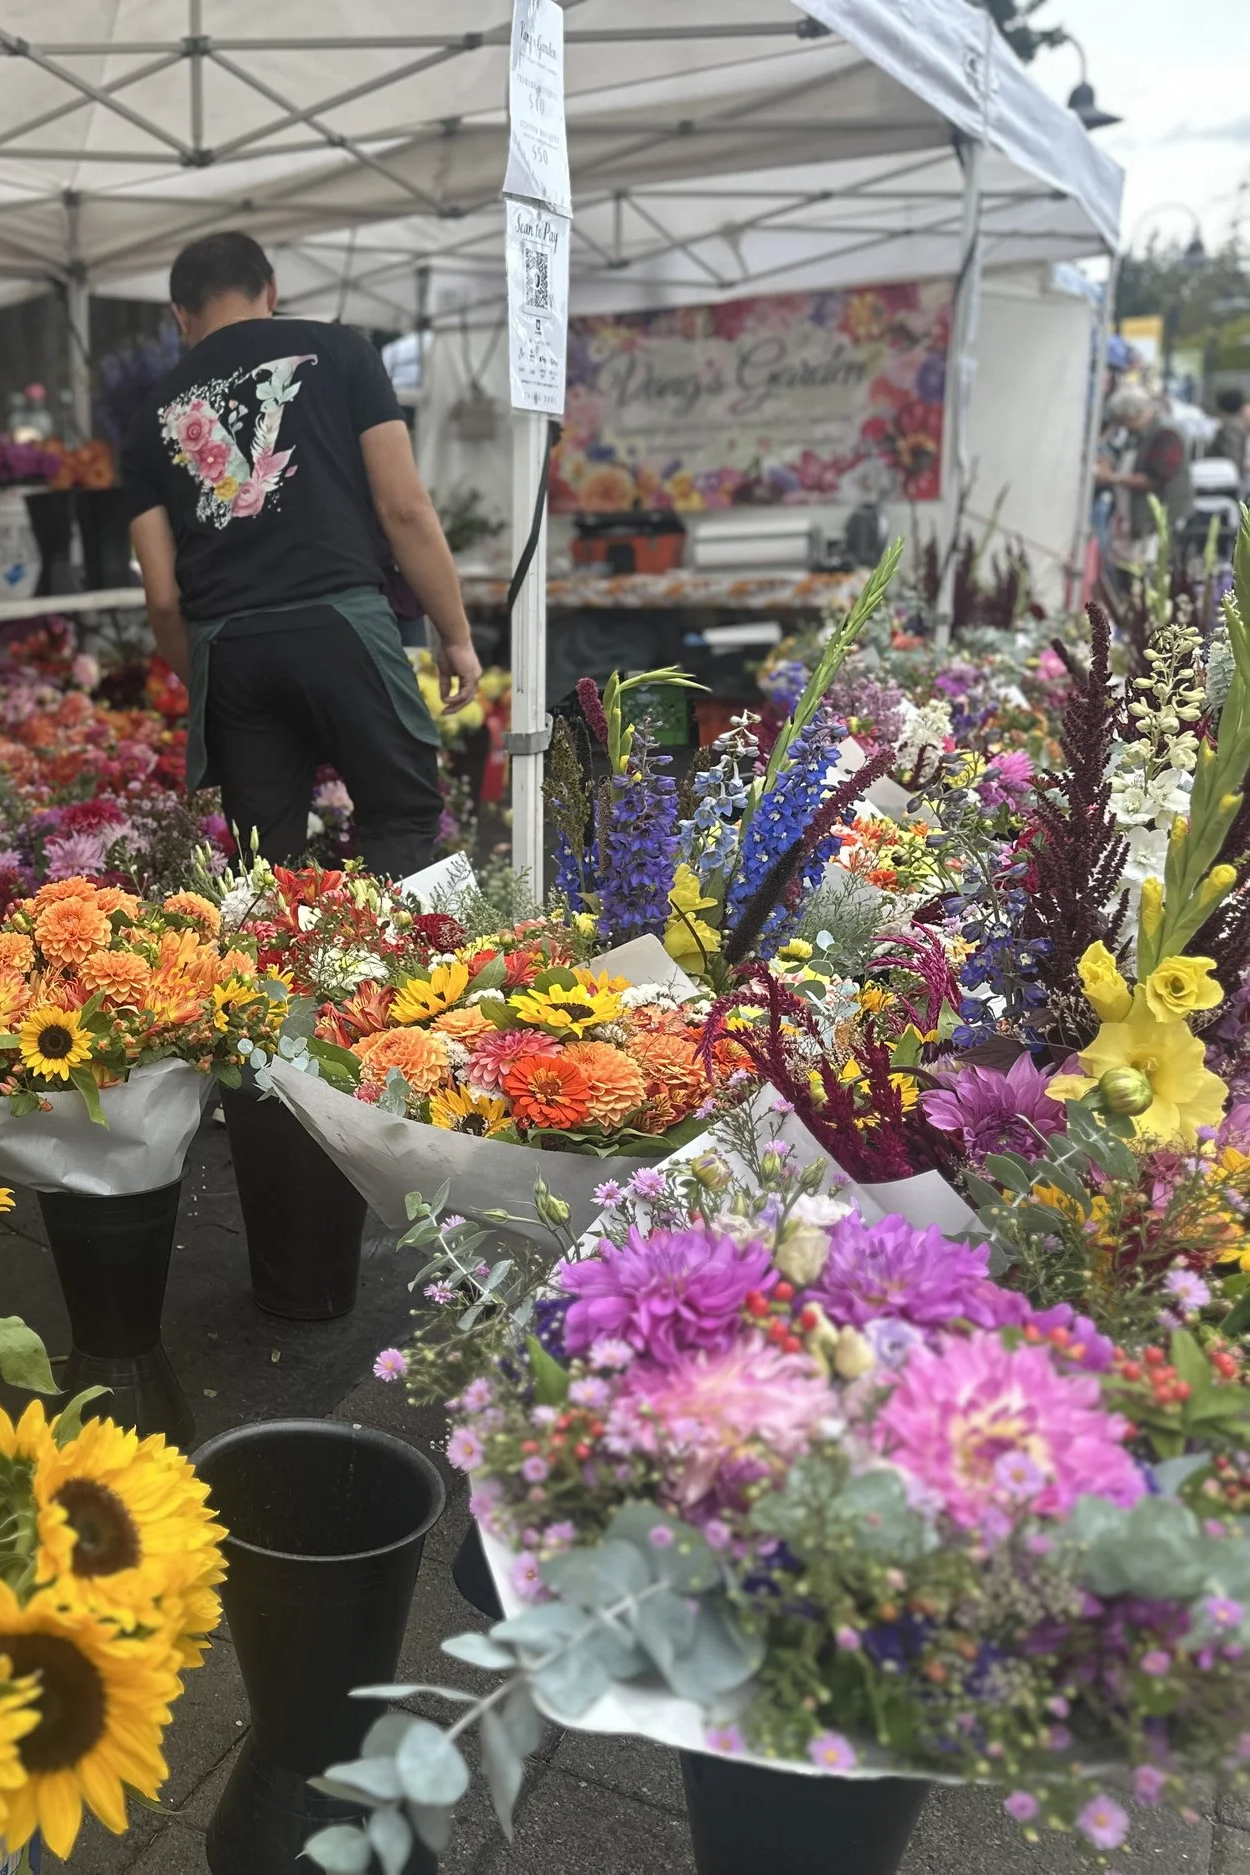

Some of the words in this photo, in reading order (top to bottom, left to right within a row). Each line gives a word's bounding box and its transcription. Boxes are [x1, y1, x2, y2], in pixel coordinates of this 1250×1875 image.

[515, 213, 534, 236] Scan
[535, 223, 542, 239] to
[543, 221, 558, 255] Pay
